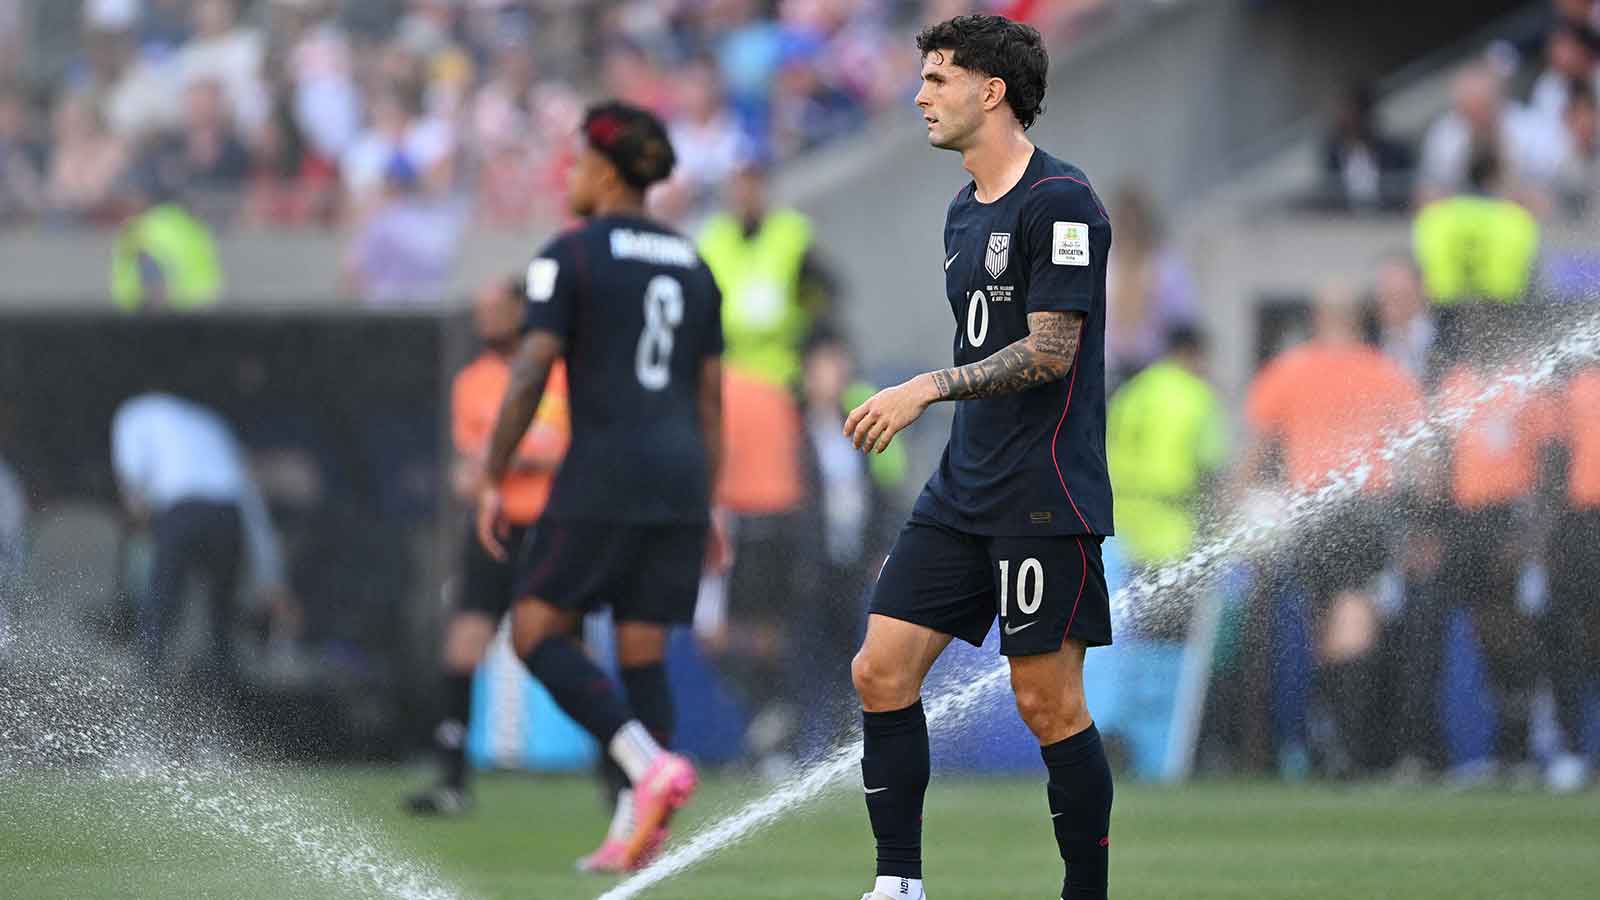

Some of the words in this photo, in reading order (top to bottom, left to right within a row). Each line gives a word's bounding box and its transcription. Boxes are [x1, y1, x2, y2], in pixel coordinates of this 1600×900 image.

[990, 235, 1008, 253] USA
[1058, 248, 1083, 256] EDUCATION
[999, 557, 1044, 617] 10
